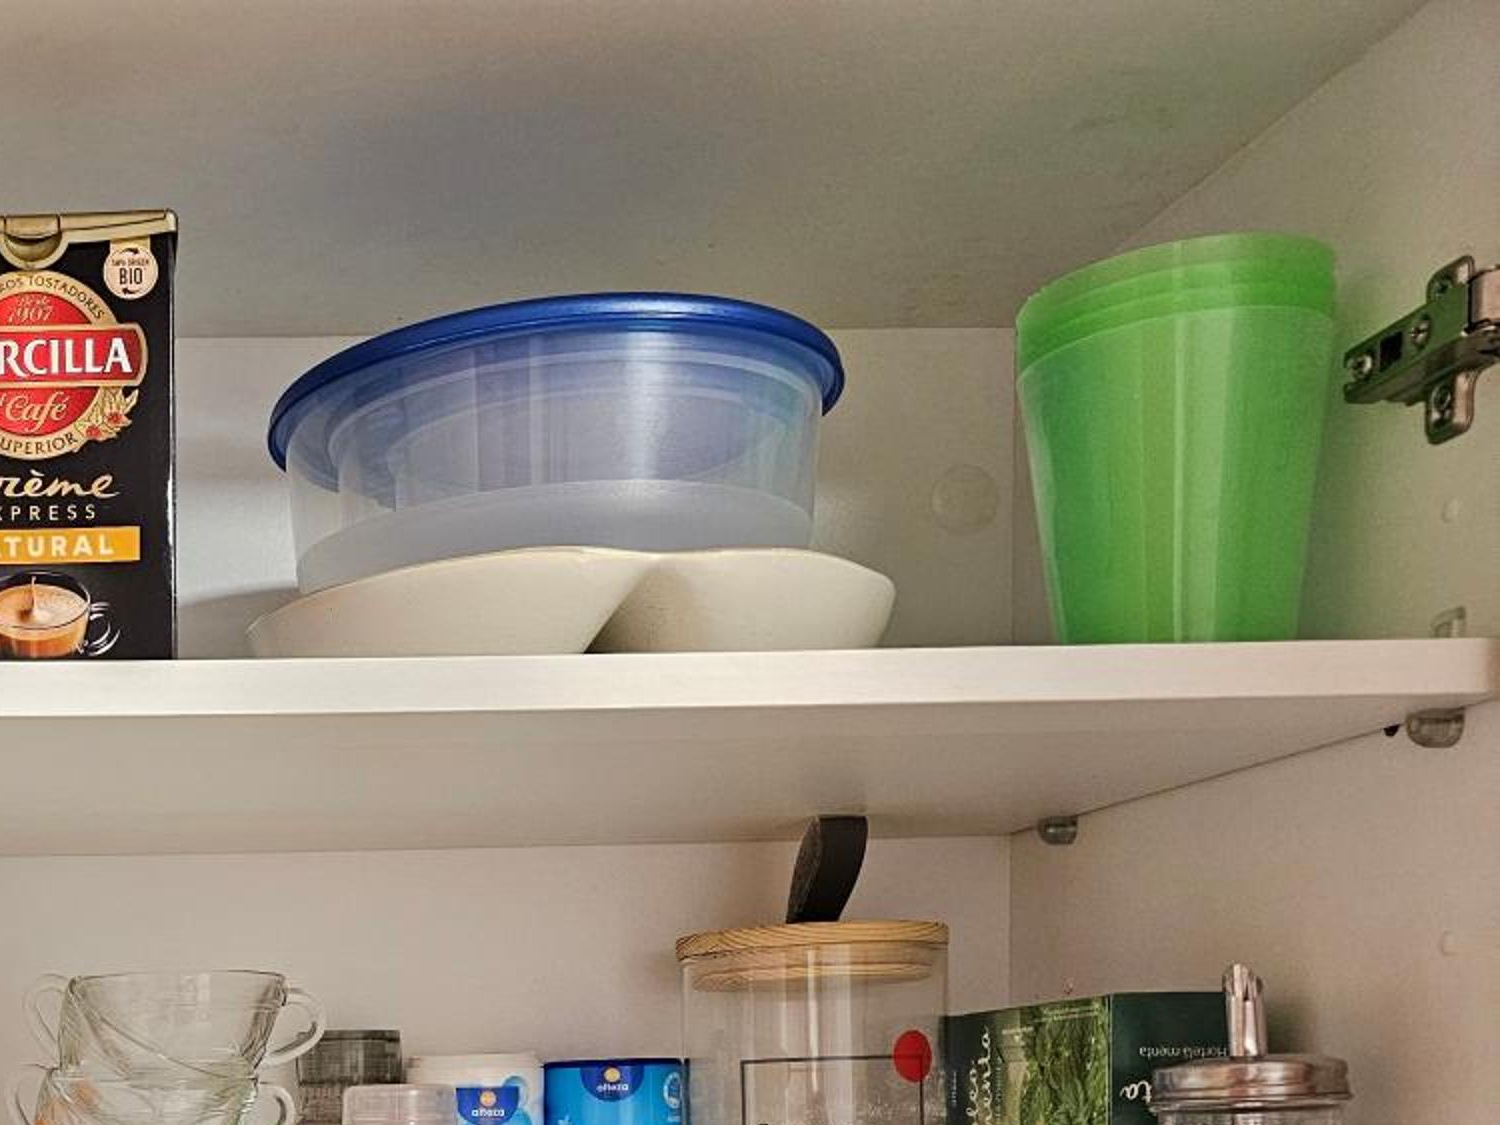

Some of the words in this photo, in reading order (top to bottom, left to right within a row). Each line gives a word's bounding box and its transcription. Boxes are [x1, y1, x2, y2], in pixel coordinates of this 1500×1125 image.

[119, 267, 143, 285] BIO
[28, 275, 106, 320] TOSTADORES
[5, 391, 70, 433] Café
[1139, 1045, 1181, 1060] menta
